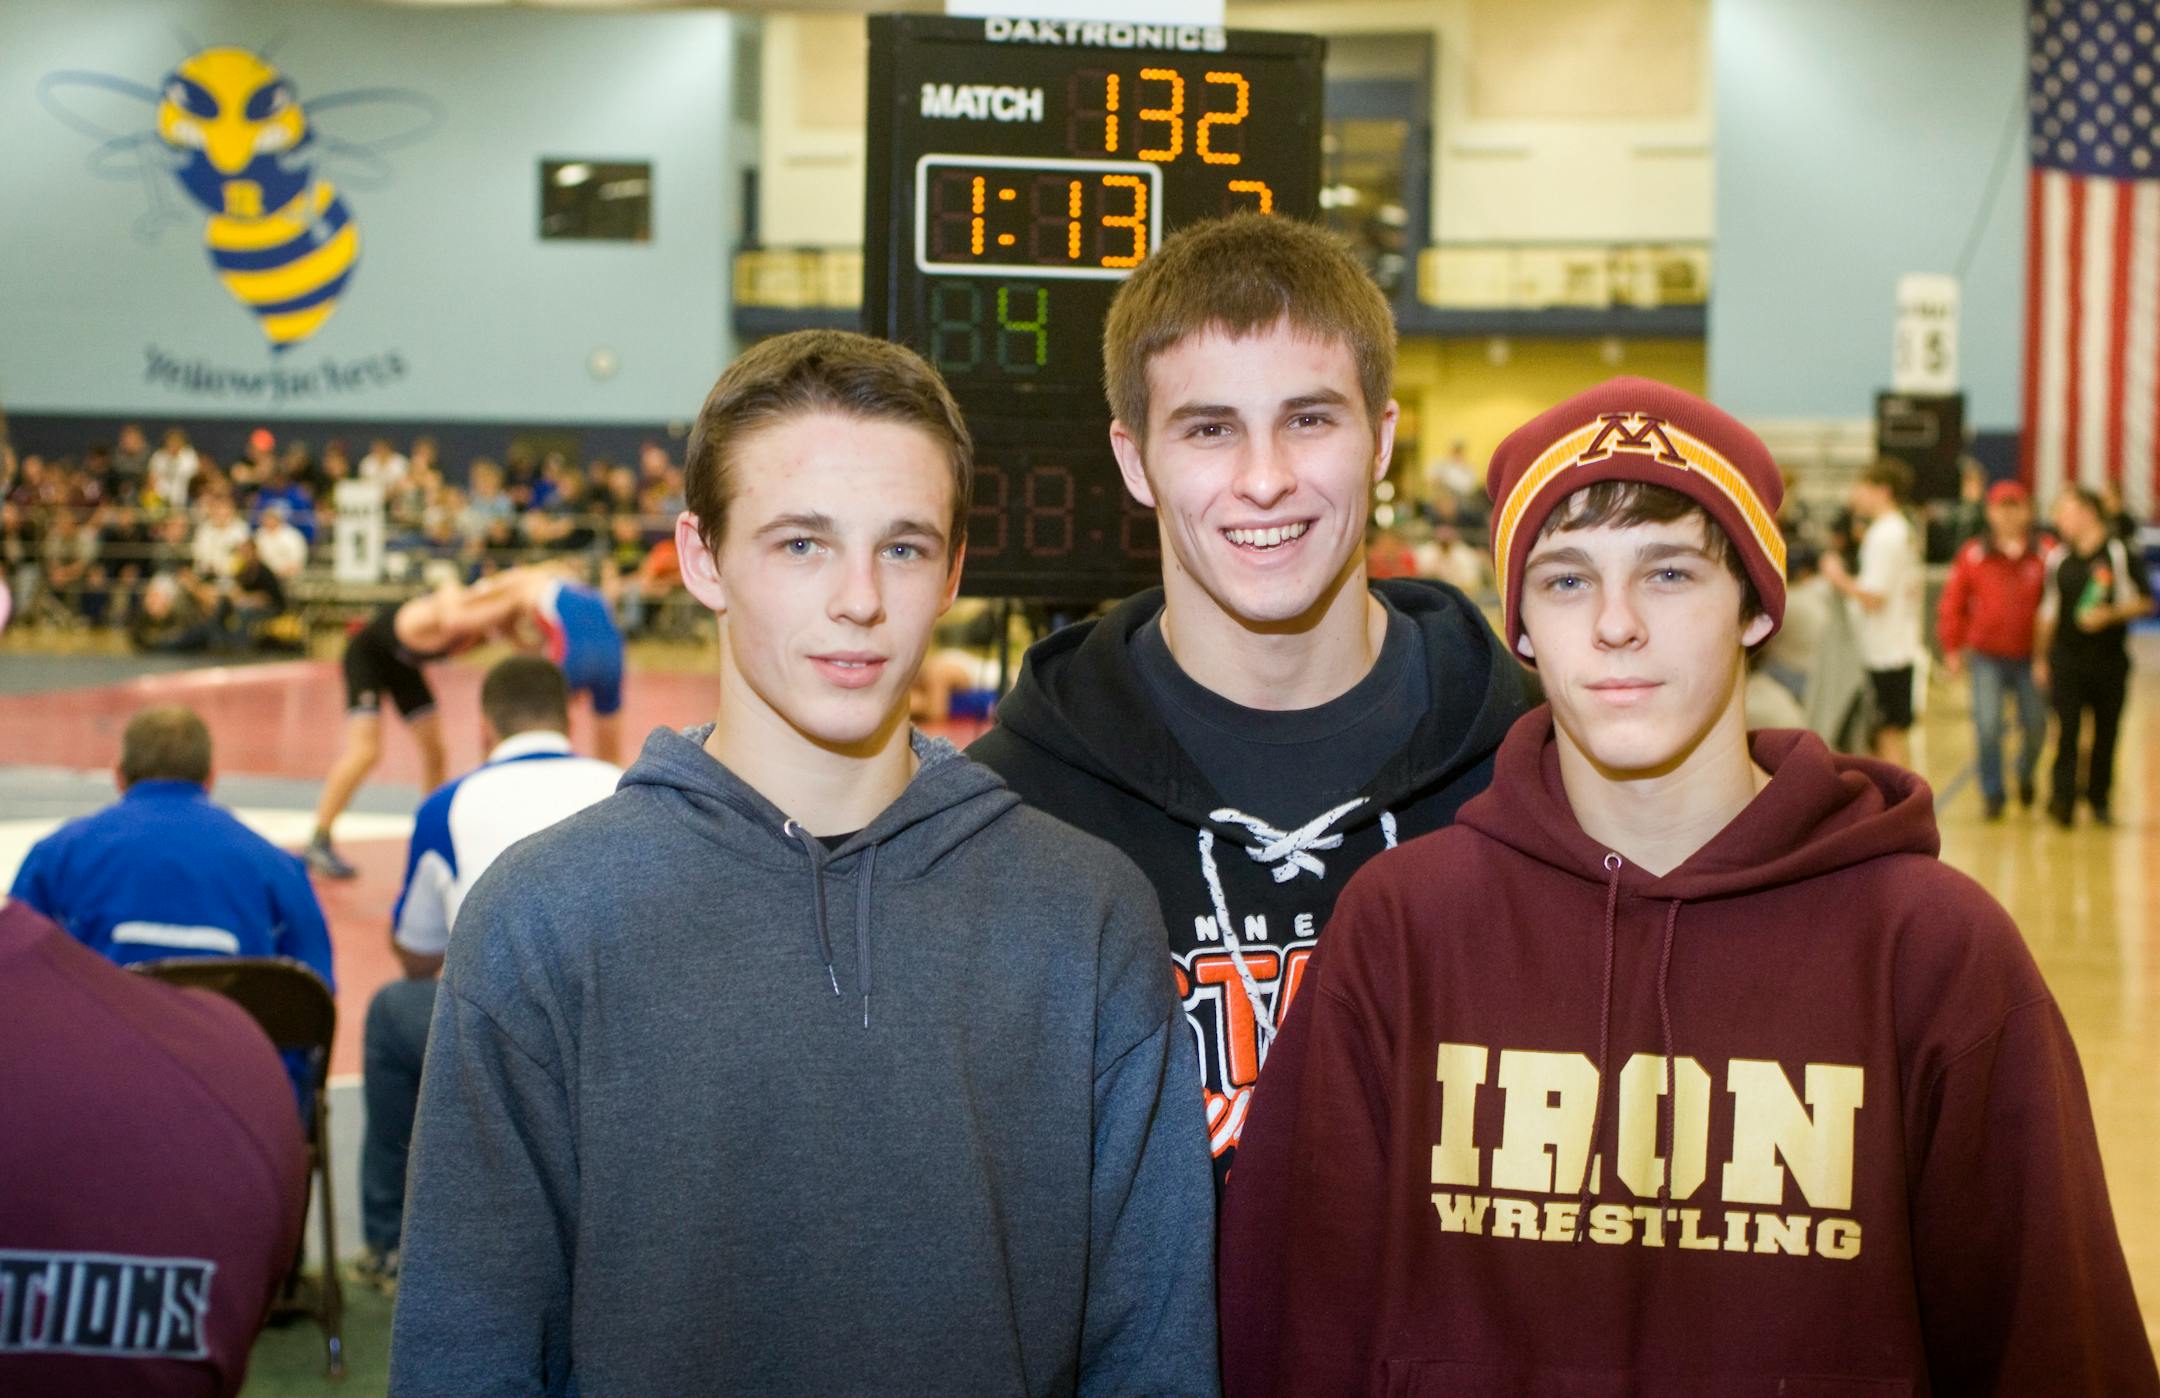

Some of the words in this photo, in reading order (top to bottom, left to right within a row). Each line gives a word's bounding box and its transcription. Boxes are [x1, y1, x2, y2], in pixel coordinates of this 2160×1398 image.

[985, 18, 1226, 52] DAKTRONICS
[921, 84, 1043, 122] MATCH
[1106, 68, 1250, 164] 132
[972, 176, 1147, 268] 1:13
[998, 288, 1048, 366] 4
[1431, 1042, 1864, 1210] IRON
[1431, 1194, 1862, 1261] WRESTLING
